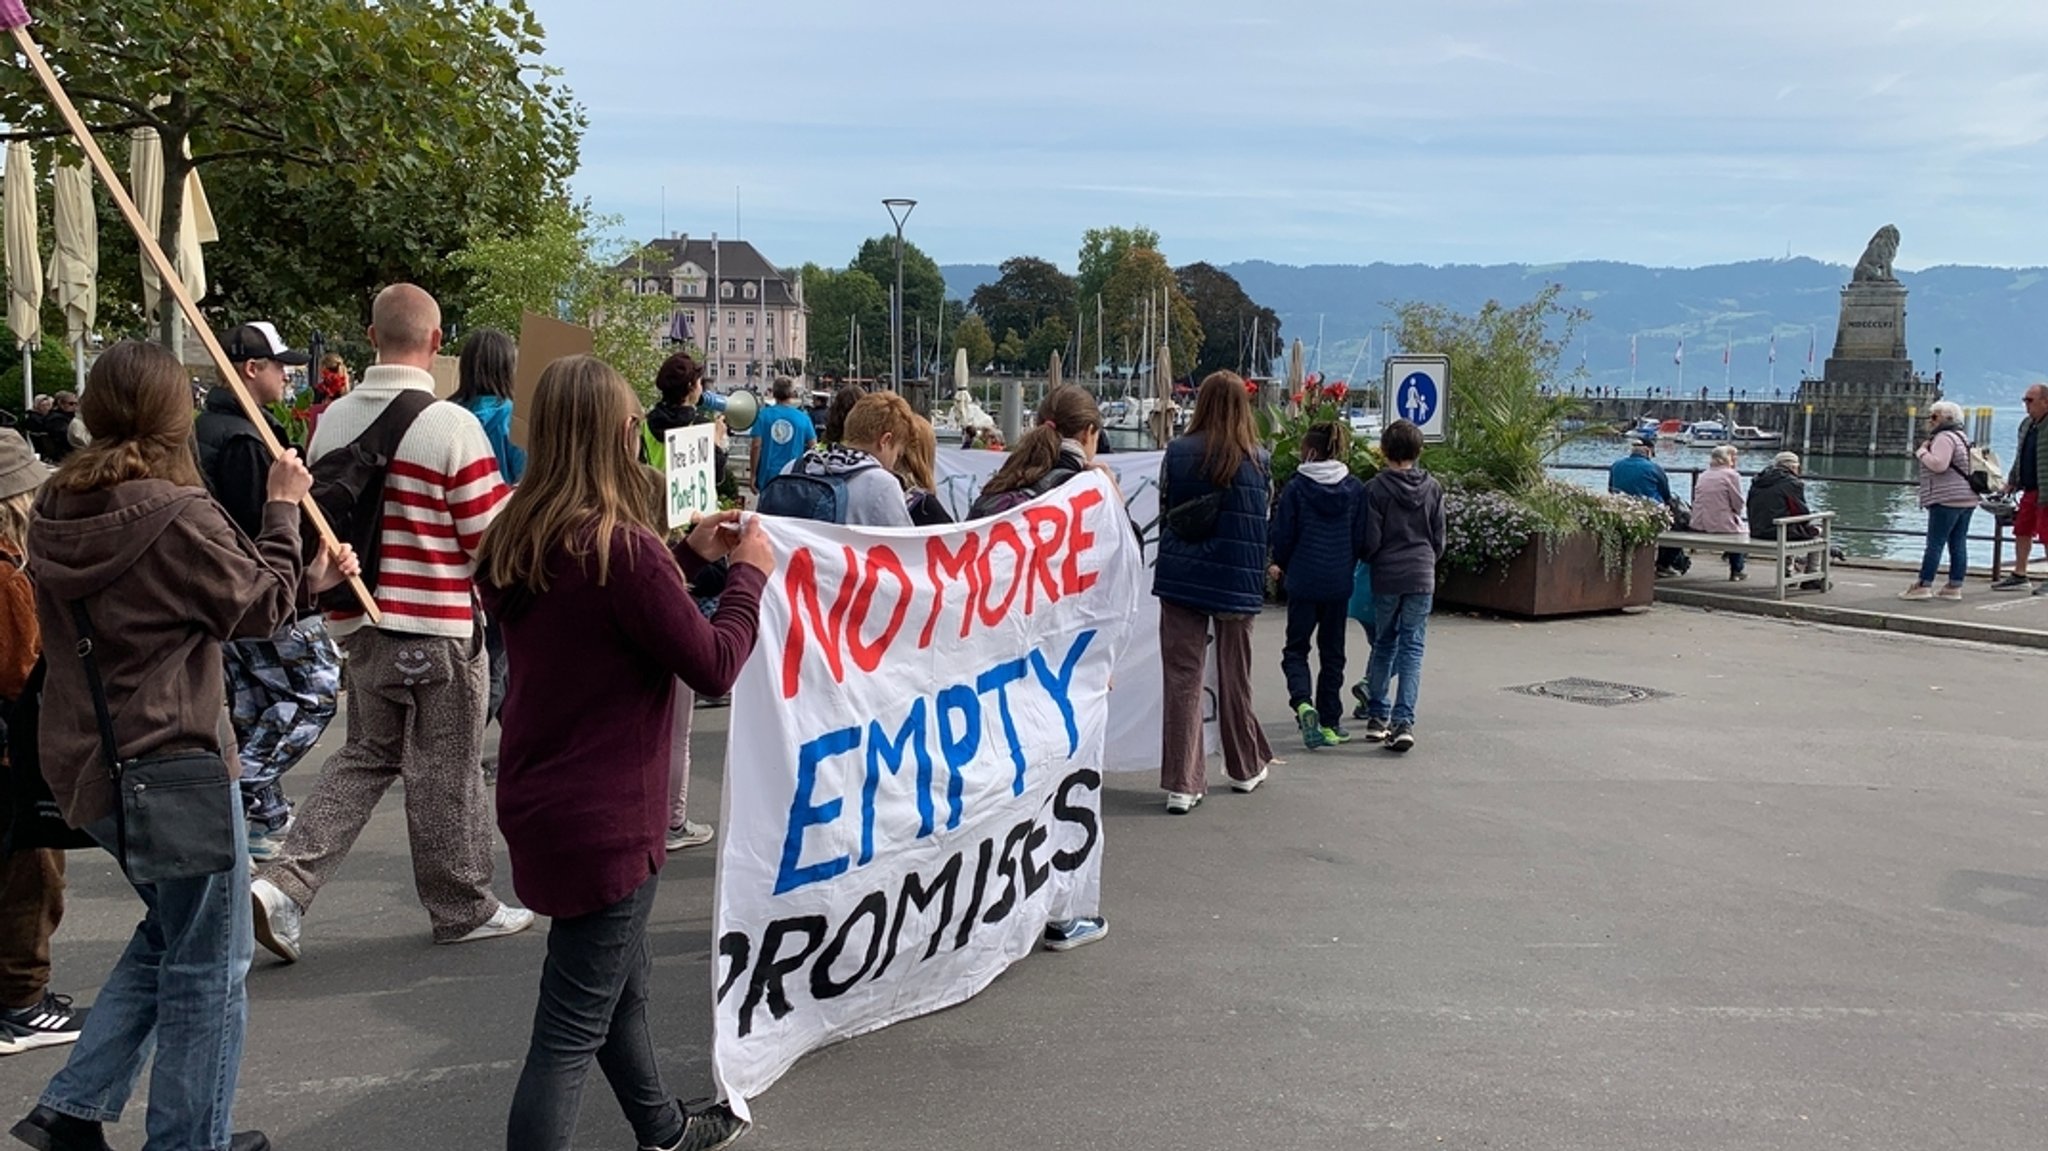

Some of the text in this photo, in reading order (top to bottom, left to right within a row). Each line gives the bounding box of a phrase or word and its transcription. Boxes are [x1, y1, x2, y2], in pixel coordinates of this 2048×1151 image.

[671, 470, 708, 515] Planet B
[689, 443, 696, 466] is
[782, 544, 914, 699] NO
[918, 488, 1103, 649] MORE
[772, 629, 1098, 896] EMPTY
[718, 768, 1101, 1038] PROMISES
